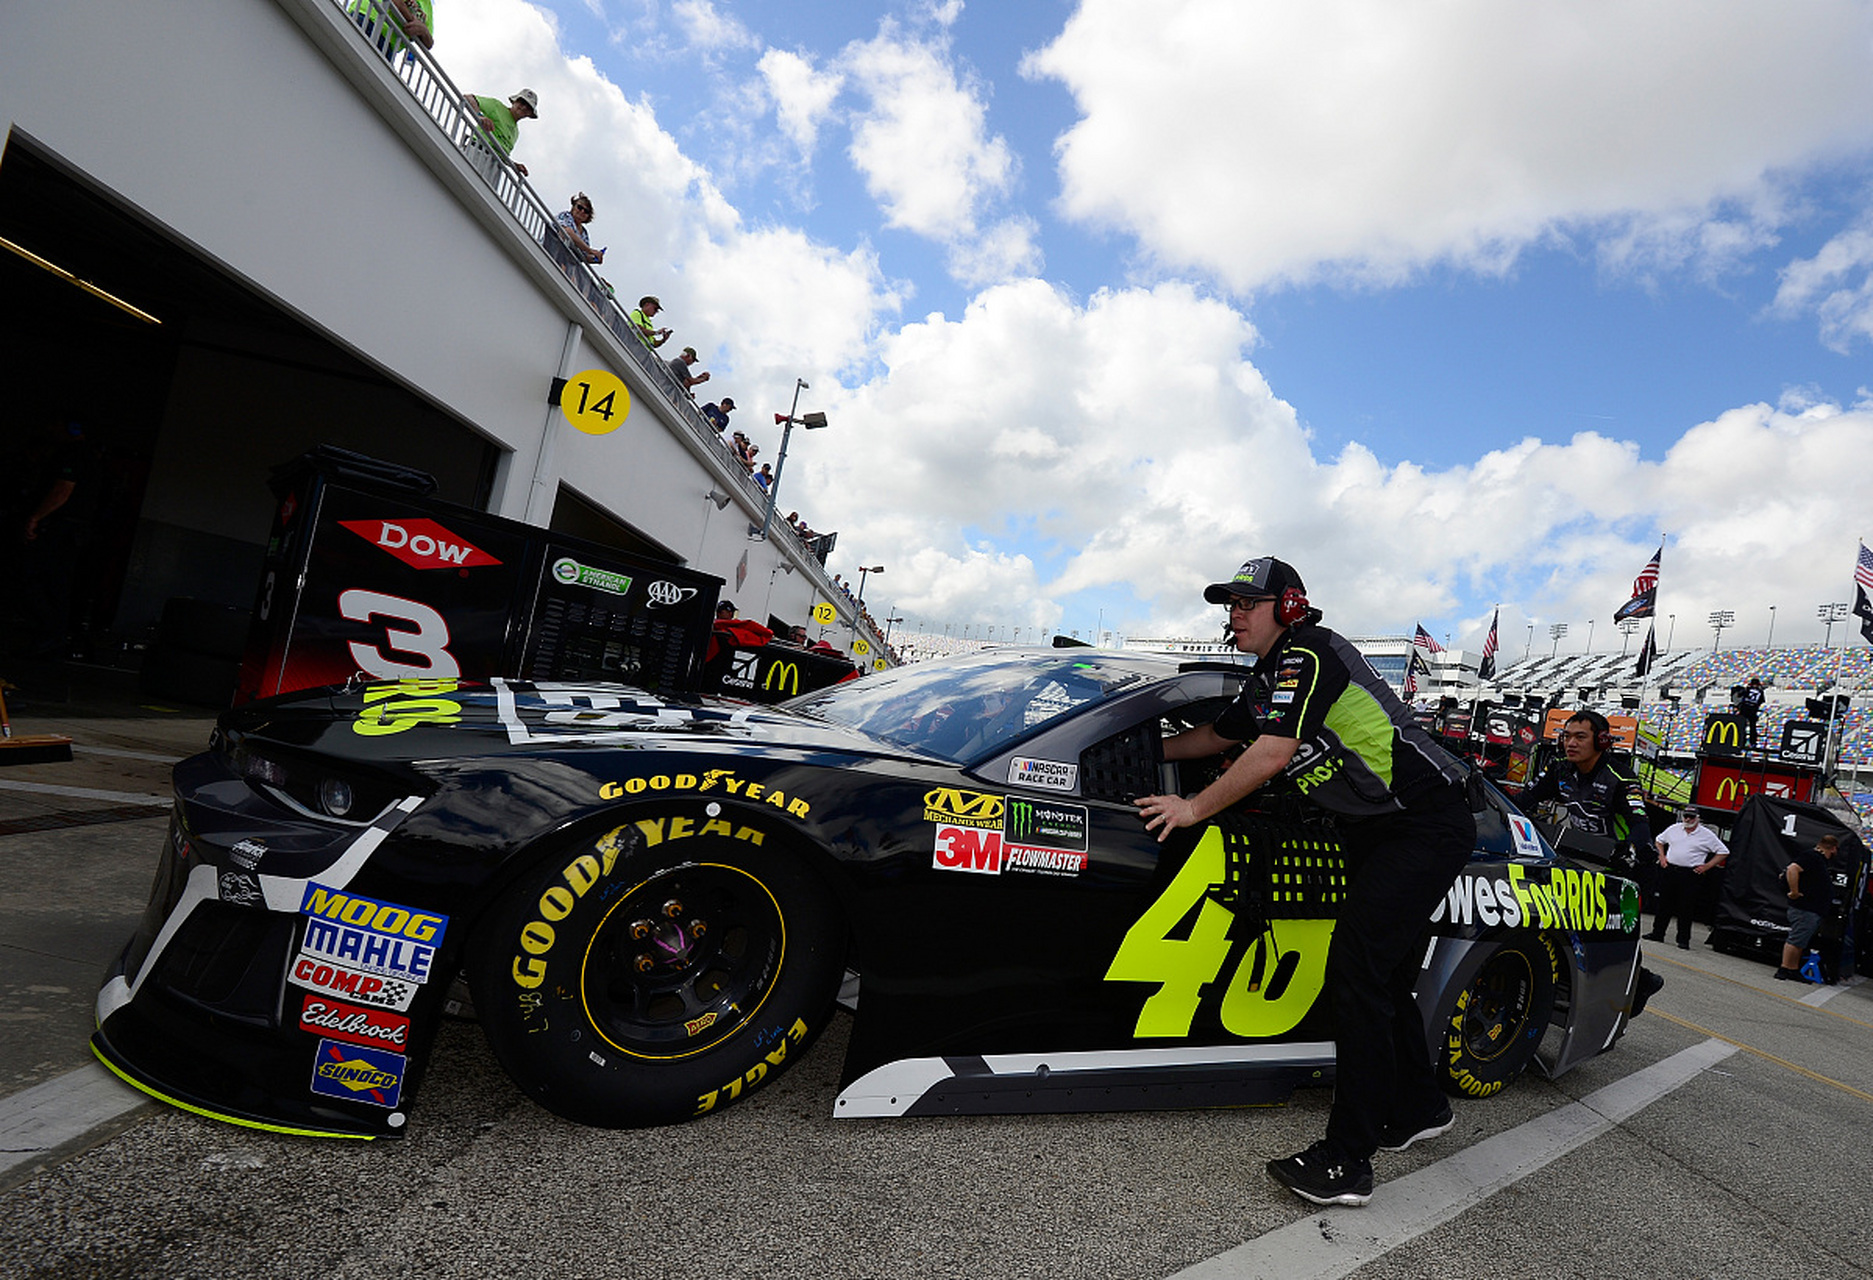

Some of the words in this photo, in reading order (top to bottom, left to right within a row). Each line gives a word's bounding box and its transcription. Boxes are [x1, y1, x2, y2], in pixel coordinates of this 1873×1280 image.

[576, 381, 618, 422] 14
[650, 580, 680, 604] AAA
[817, 605, 833, 621] 12
[337, 587, 462, 680] 3
[855, 642, 869, 653] 10
[1488, 719, 1512, 738] 3
[1018, 772, 1045, 784] RACE
[1046, 776, 1067, 787] CAR
[1031, 761, 1069, 777] NASCAR
[923, 808, 976, 827] MECHANIX
[975, 818, 1004, 830] WEAR
[1035, 808, 1084, 825] MONSTER
[1781, 814, 1798, 838] 1
[935, 827, 1002, 872] 3M
[1005, 847, 1082, 872] FLOWMASTER
[305, 888, 443, 942] MOOG
[304, 917, 431, 977] MAHLE
[295, 959, 383, 994] COMP
[349, 990, 397, 1007] CAMS
[301, 1001, 407, 1046] Edelbrock
[321, 1064, 396, 1088] SUNOCO
[692, 1017, 809, 1116] EAGLE
